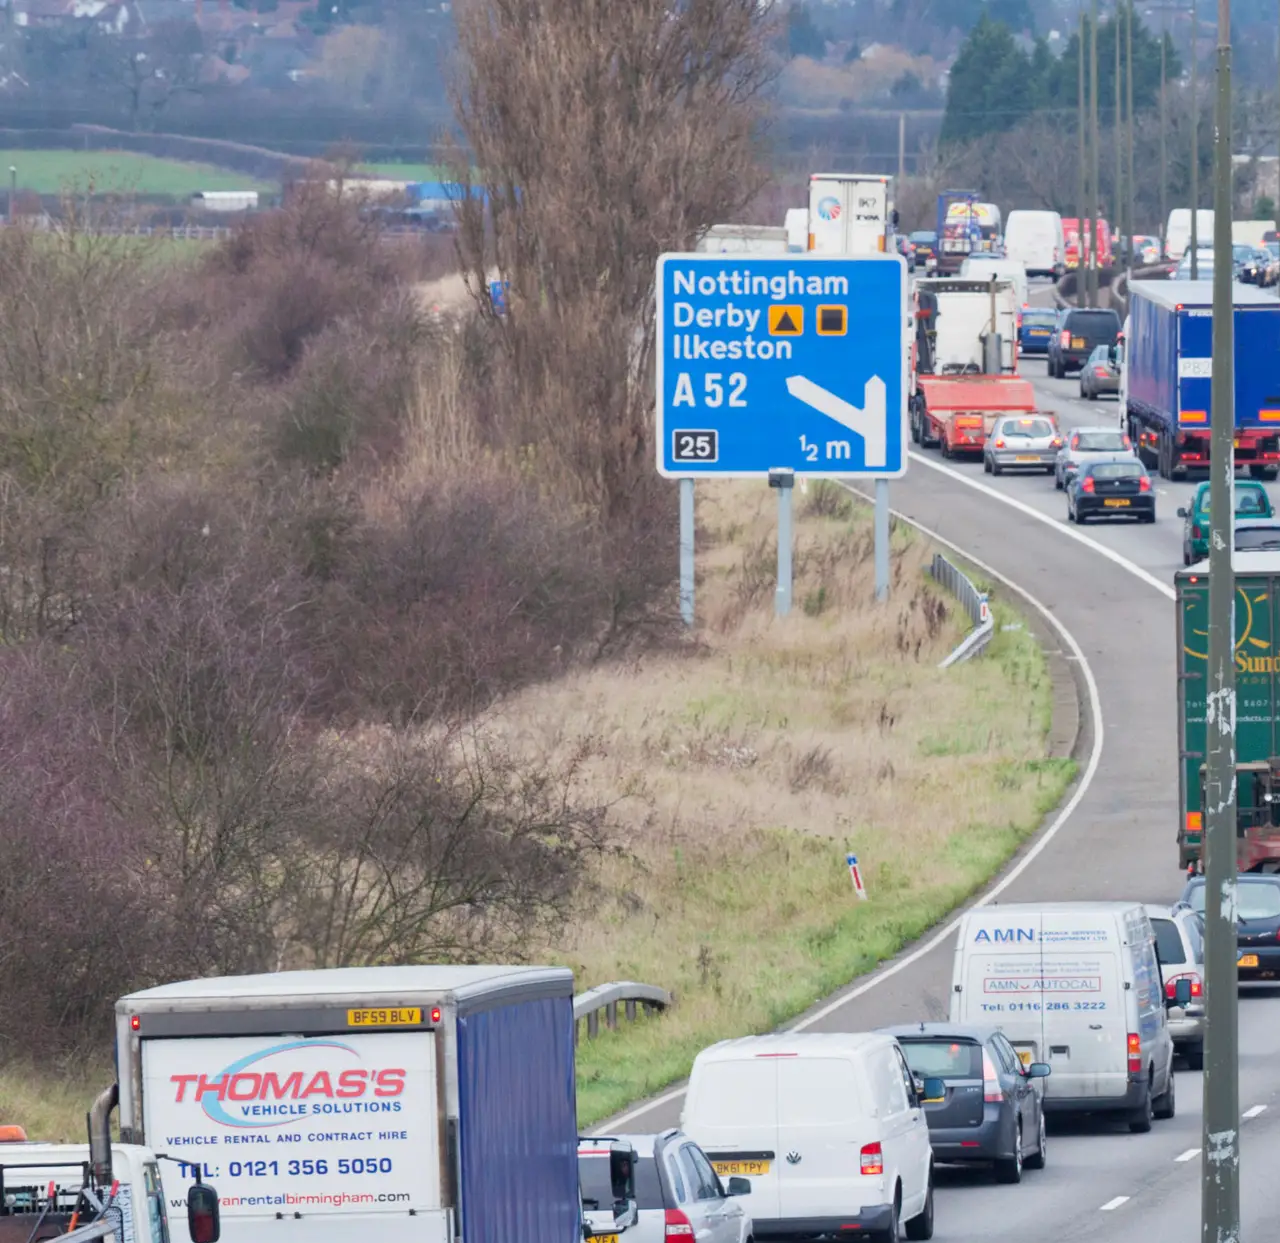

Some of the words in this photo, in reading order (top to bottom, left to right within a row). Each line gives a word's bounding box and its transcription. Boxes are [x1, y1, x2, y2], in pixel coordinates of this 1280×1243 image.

[673, 270, 849, 300] Nottingham
[673, 302, 761, 332] Derby
[673, 334, 793, 360] Ilkeston
[680, 436, 711, 457] 25
[826, 440, 851, 459] m
[974, 927, 1034, 943] AMN
[989, 980, 1019, 990] AMN
[1033, 979, 1097, 989] AUTOCAL
[980, 1003, 1005, 1012] Tel:
[1008, 1003, 1041, 1011] 0116
[1046, 1002, 1070, 1011] 286
[1074, 1002, 1107, 1010] 3222
[353, 1011, 387, 1024] BF59
[390, 1010, 415, 1023] BLV
[169, 1068, 407, 1104] THOMAS'S
[241, 1104, 307, 1117] VEHICLE
[313, 1101, 402, 1115] SOLUTIONS
[166, 1136, 218, 1146] VEHICLE
[224, 1134, 271, 1144] RENTAL
[277, 1133, 302, 1143] AND
[307, 1131, 374, 1142] CONTRACT
[378, 1130, 408, 1141] HIRE
[228, 1160, 279, 1177] 0121
[287, 1158, 328, 1176] 356
[337, 1157, 393, 1174] 5050
[743, 1161, 765, 1174] TPY
